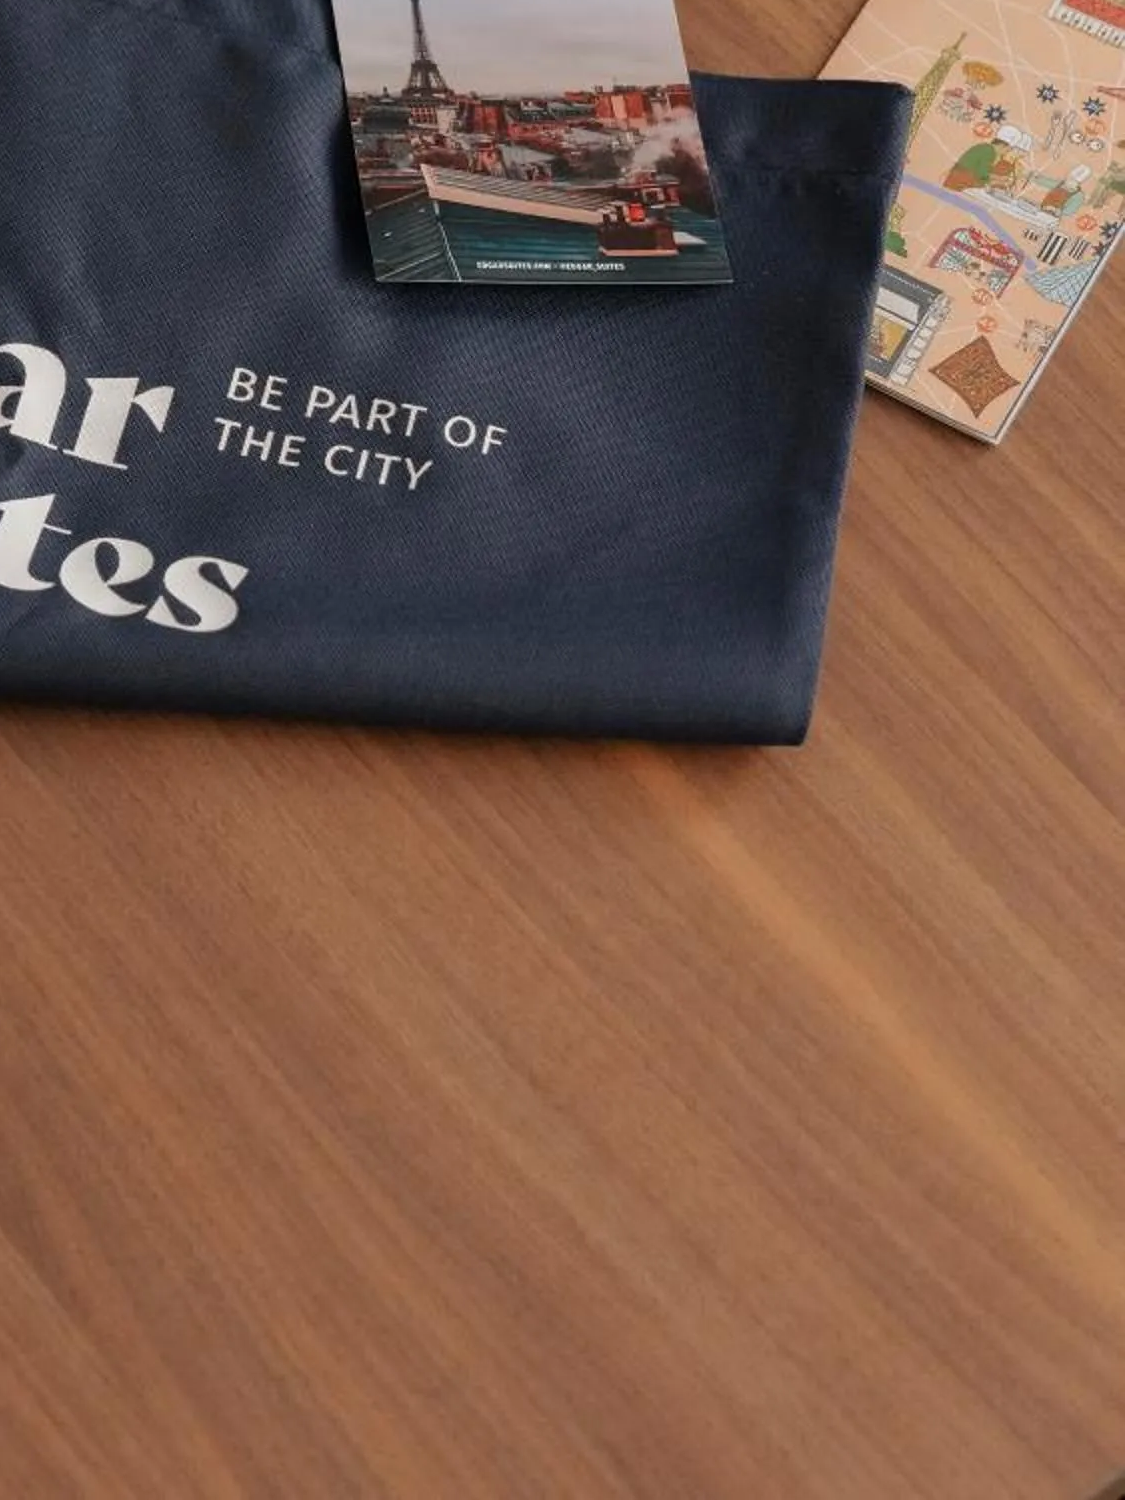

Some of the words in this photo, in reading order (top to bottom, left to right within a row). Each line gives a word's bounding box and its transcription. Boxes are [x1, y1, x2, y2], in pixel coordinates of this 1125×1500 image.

[226, 367, 288, 411] BE
[305, 385, 428, 437] PART
[443, 415, 508, 455] OF
[214, 417, 306, 467] THE
[324, 444, 434, 490] CITY
